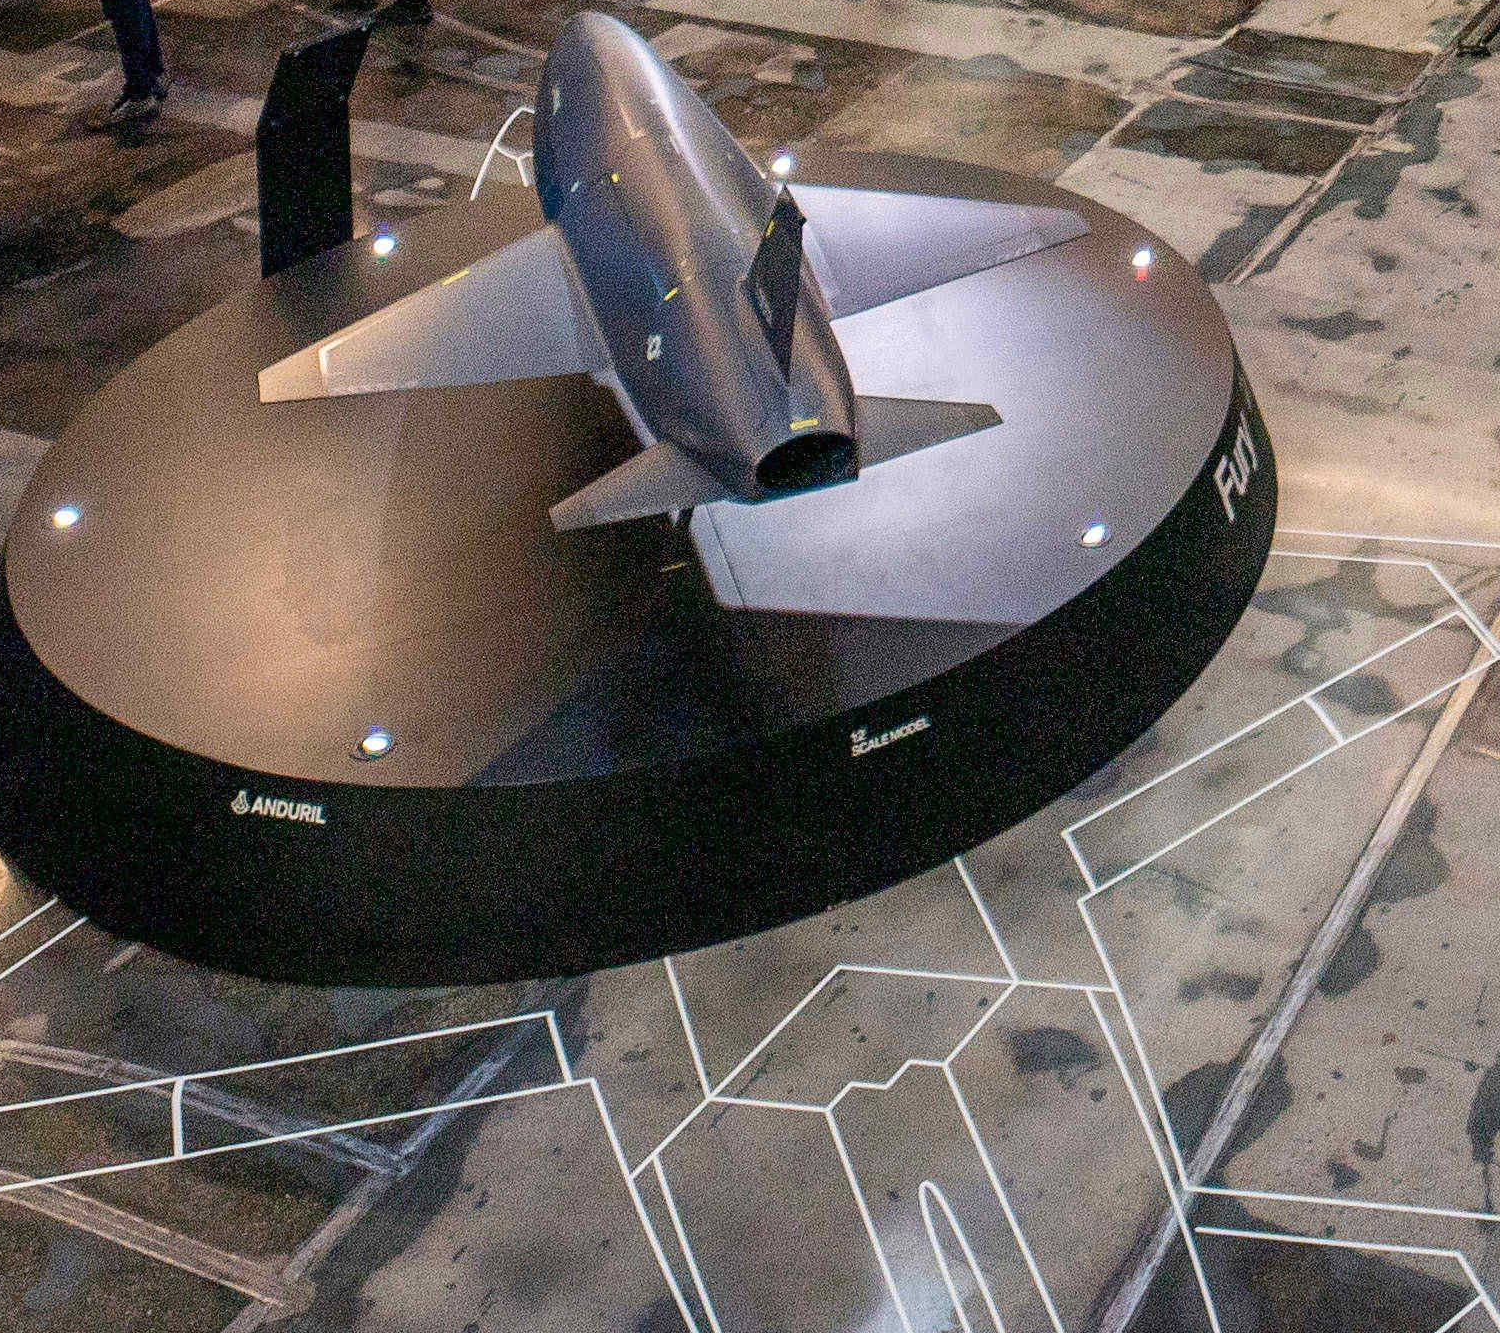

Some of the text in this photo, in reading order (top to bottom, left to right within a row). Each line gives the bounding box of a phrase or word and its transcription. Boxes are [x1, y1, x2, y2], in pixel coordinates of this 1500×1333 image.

[1214, 410, 1259, 523] Fury
[851, 717, 931, 757] SCALE MODEL
[250, 795, 327, 825] ANDURIL
